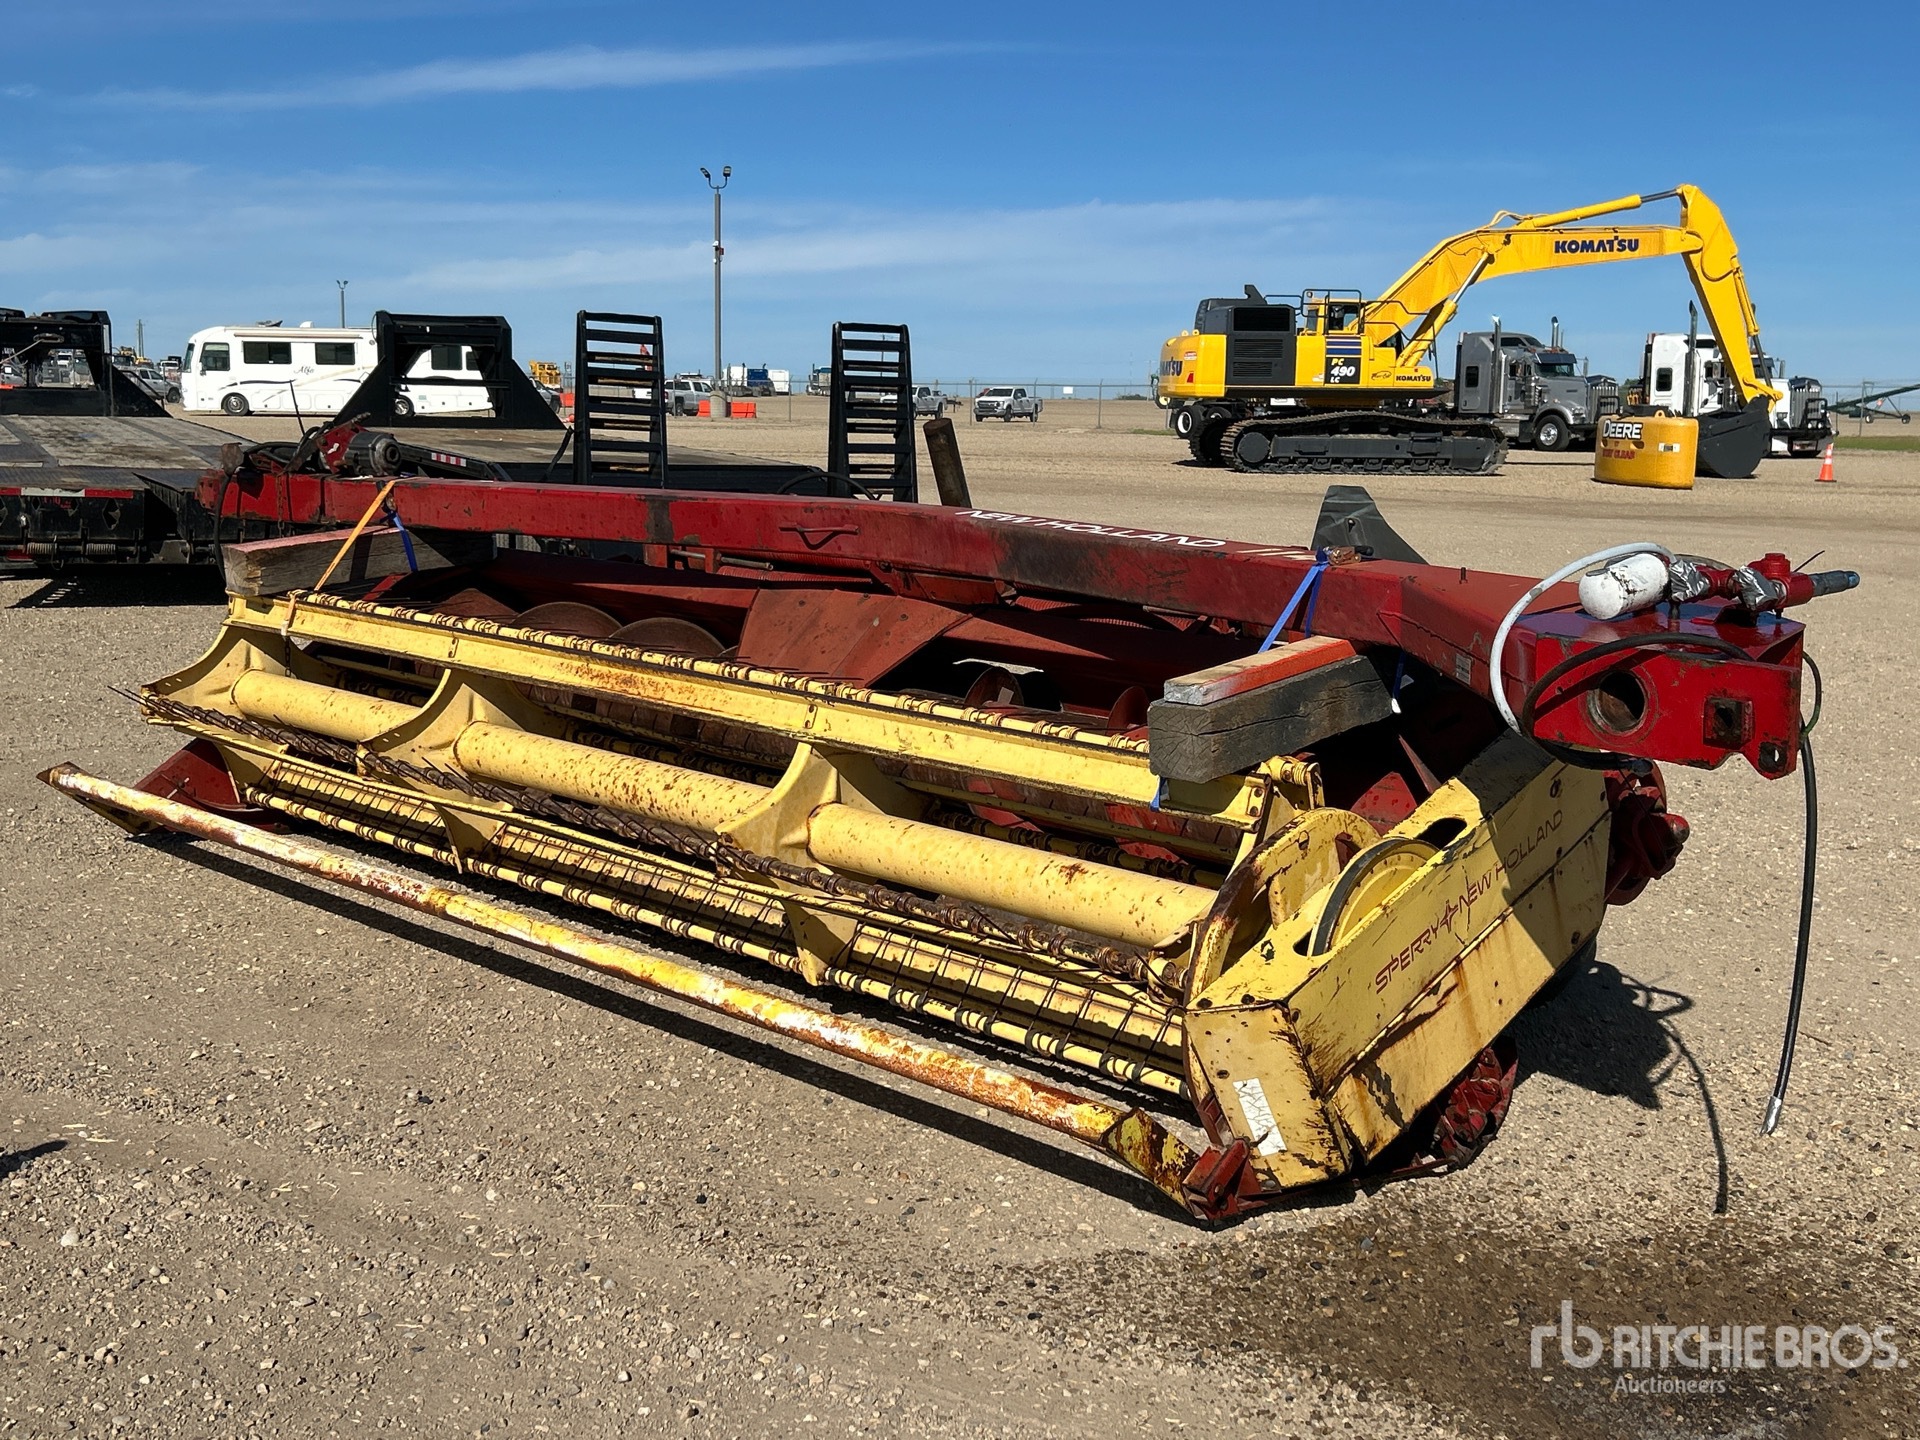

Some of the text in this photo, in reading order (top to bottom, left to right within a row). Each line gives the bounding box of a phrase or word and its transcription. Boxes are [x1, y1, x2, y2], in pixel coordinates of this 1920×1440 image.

[1554, 235, 1640, 254] KOMATSU
[1331, 357, 1345, 366] PC
[1329, 365, 1356, 377] 490
[1395, 373, 1432, 382] KOMATSU
[1329, 375, 1341, 384] LC
[1602, 419, 1644, 440] DEERE
[954, 509, 1226, 548] NEW HOLLAND
[1375, 808, 1563, 995] SPERRY NEW HOLLAND
